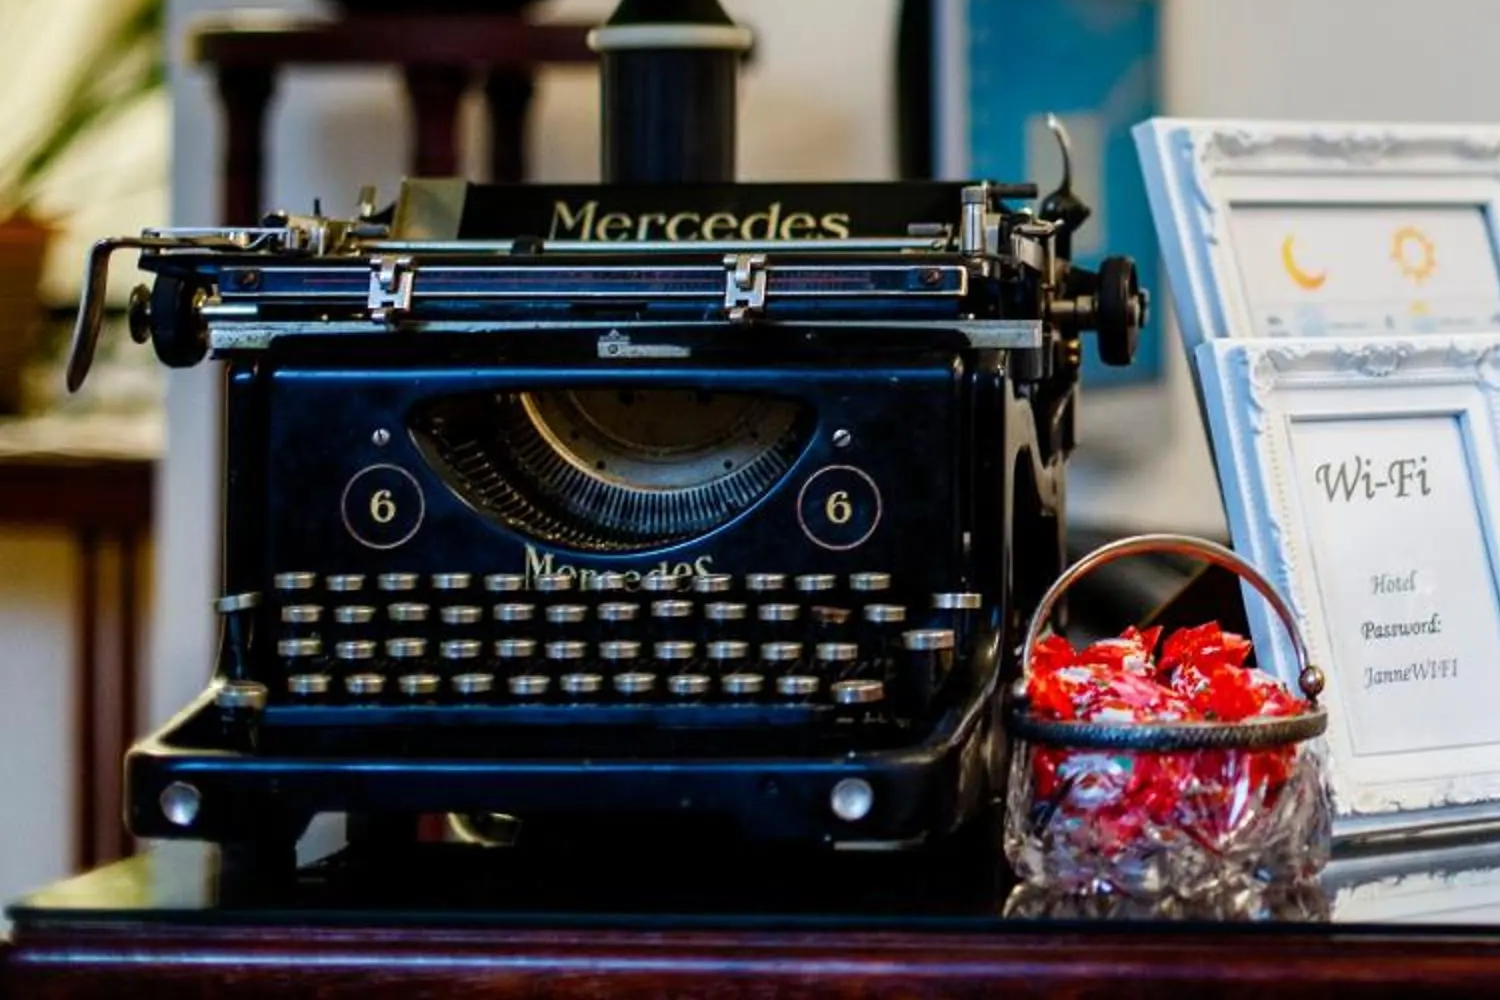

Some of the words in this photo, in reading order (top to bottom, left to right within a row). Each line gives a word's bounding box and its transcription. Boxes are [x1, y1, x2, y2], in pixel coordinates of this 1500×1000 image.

[550, 201, 849, 241] Mercedes
[1315, 456, 1431, 502] Wi-Fi
[371, 490, 396, 523] 6
[827, 491, 852, 524] 6
[523, 542, 714, 592] Mredes
[1371, 570, 1418, 594] Hotel
[1361, 613, 1441, 640] Password:
